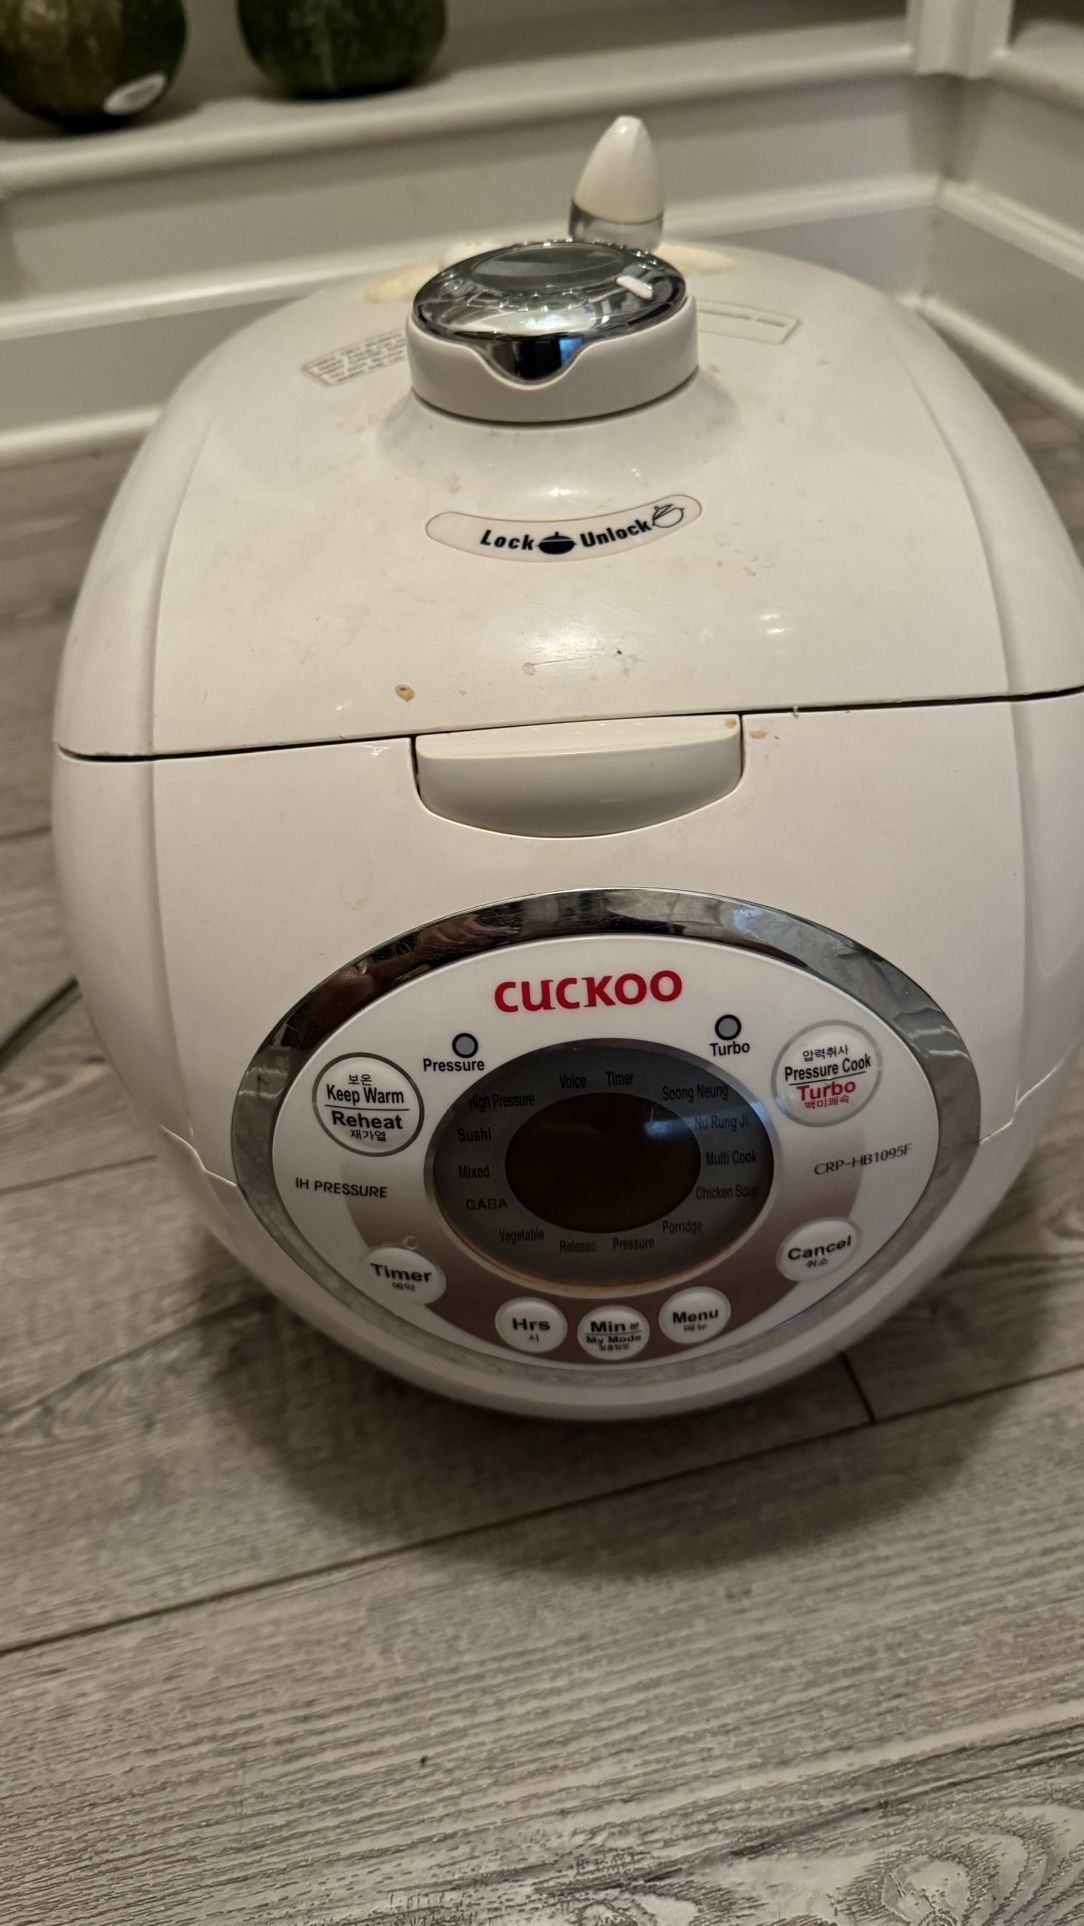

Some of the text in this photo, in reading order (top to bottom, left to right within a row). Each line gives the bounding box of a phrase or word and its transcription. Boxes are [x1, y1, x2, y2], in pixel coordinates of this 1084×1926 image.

[479, 529, 535, 551] Lock
[579, 518, 653, 548] Unlock
[494, 970, 683, 1013] CUCKOO
[709, 1041, 751, 1057] Turbo
[802, 1044, 849, 1063] 압력취사
[423, 1058, 485, 1072] Pressure
[784, 1053, 872, 1081] Pressure Cook
[348, 1073, 373, 1086] 보온
[559, 1074, 587, 1089] Voice
[606, 1071, 634, 1087] Timer
[326, 1084, 405, 1106] Keep Warm
[662, 1083, 729, 1103] Soong Neung
[796, 1080, 857, 1101] Turbo
[469, 1093, 535, 1113] High Pressure
[332, 1110, 404, 1129] Reheat
[711, 1115, 737, 1132] Rung
[350, 1129, 387, 1142] 재가열
[458, 1127, 492, 1142] Sushi
[706, 1150, 758, 1166] Multi Cook
[814, 1143, 912, 1176] CRP-HB1095F
[458, 1164, 490, 1179] Mixed
[295, 1177, 388, 1198] IH PRESSURE
[696, 1184, 760, 1200] Chicken Soup
[466, 1198, 508, 1211] GABA
[499, 1228, 545, 1245] Vegetable
[613, 1237, 655, 1251] Pressure
[787, 1234, 852, 1260] Cancel
[369, 1263, 433, 1282] Timer
[512, 1317, 551, 1332] Hrs
[672, 1309, 720, 1324] Menu
[590, 1320, 627, 1334] Min
[586, 1334, 642, 1345] My Mode
